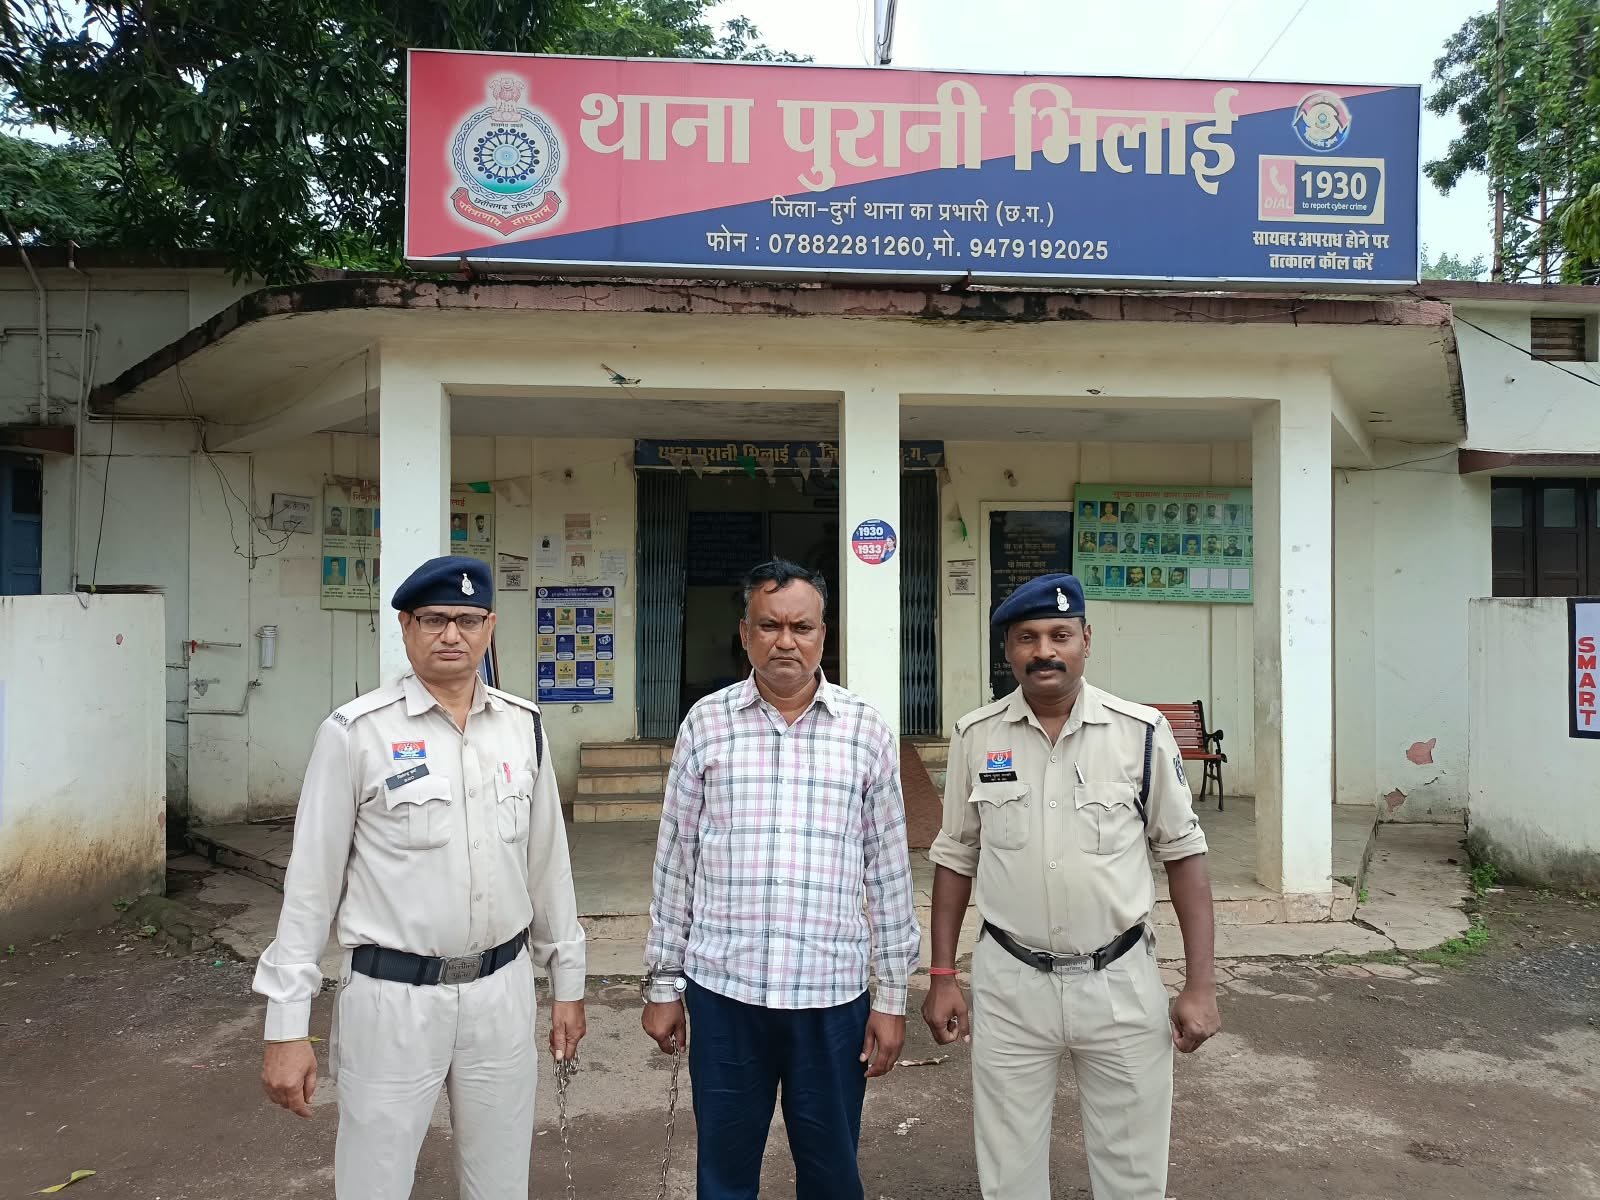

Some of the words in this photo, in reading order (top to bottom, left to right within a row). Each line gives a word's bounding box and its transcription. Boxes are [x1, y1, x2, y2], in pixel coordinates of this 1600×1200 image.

[579, 92, 755, 164] थाना
[777, 80, 987, 192] पुरानी
[1010, 80, 1239, 195] भिलाई
[1301, 170, 1367, 200] 1930
[770, 195, 857, 225] जिला-दुर्ग
[863, 202, 905, 220] थाना
[910, 203, 933, 221] का
[938, 198, 990, 222] प्रभारी
[995, 200, 1055, 228] (छ.ग.)
[1263, 197, 1293, 209] DIAL
[1302, 201, 1309, 209] to
[1310, 202, 1331, 210] report
[1331, 202, 1349, 211] cyber
[1349, 203, 1367, 211] crime
[706, 224, 748, 253] फोन
[969, 238, 1109, 260] 9479192025
[1252, 230, 1297, 247] सायबर
[1298, 231, 1343, 248] अपराध
[1344, 229, 1370, 249] होने
[1371, 234, 1390, 249] पर
[1268, 253, 1317, 269] तत्काल
[1317, 251, 1351, 270] कॉल
[1351, 252, 1375, 271] करें
[858, 526, 884, 537] 1930
[857, 544, 882, 555] 1933
[1577, 636, 1597, 726] SMART
